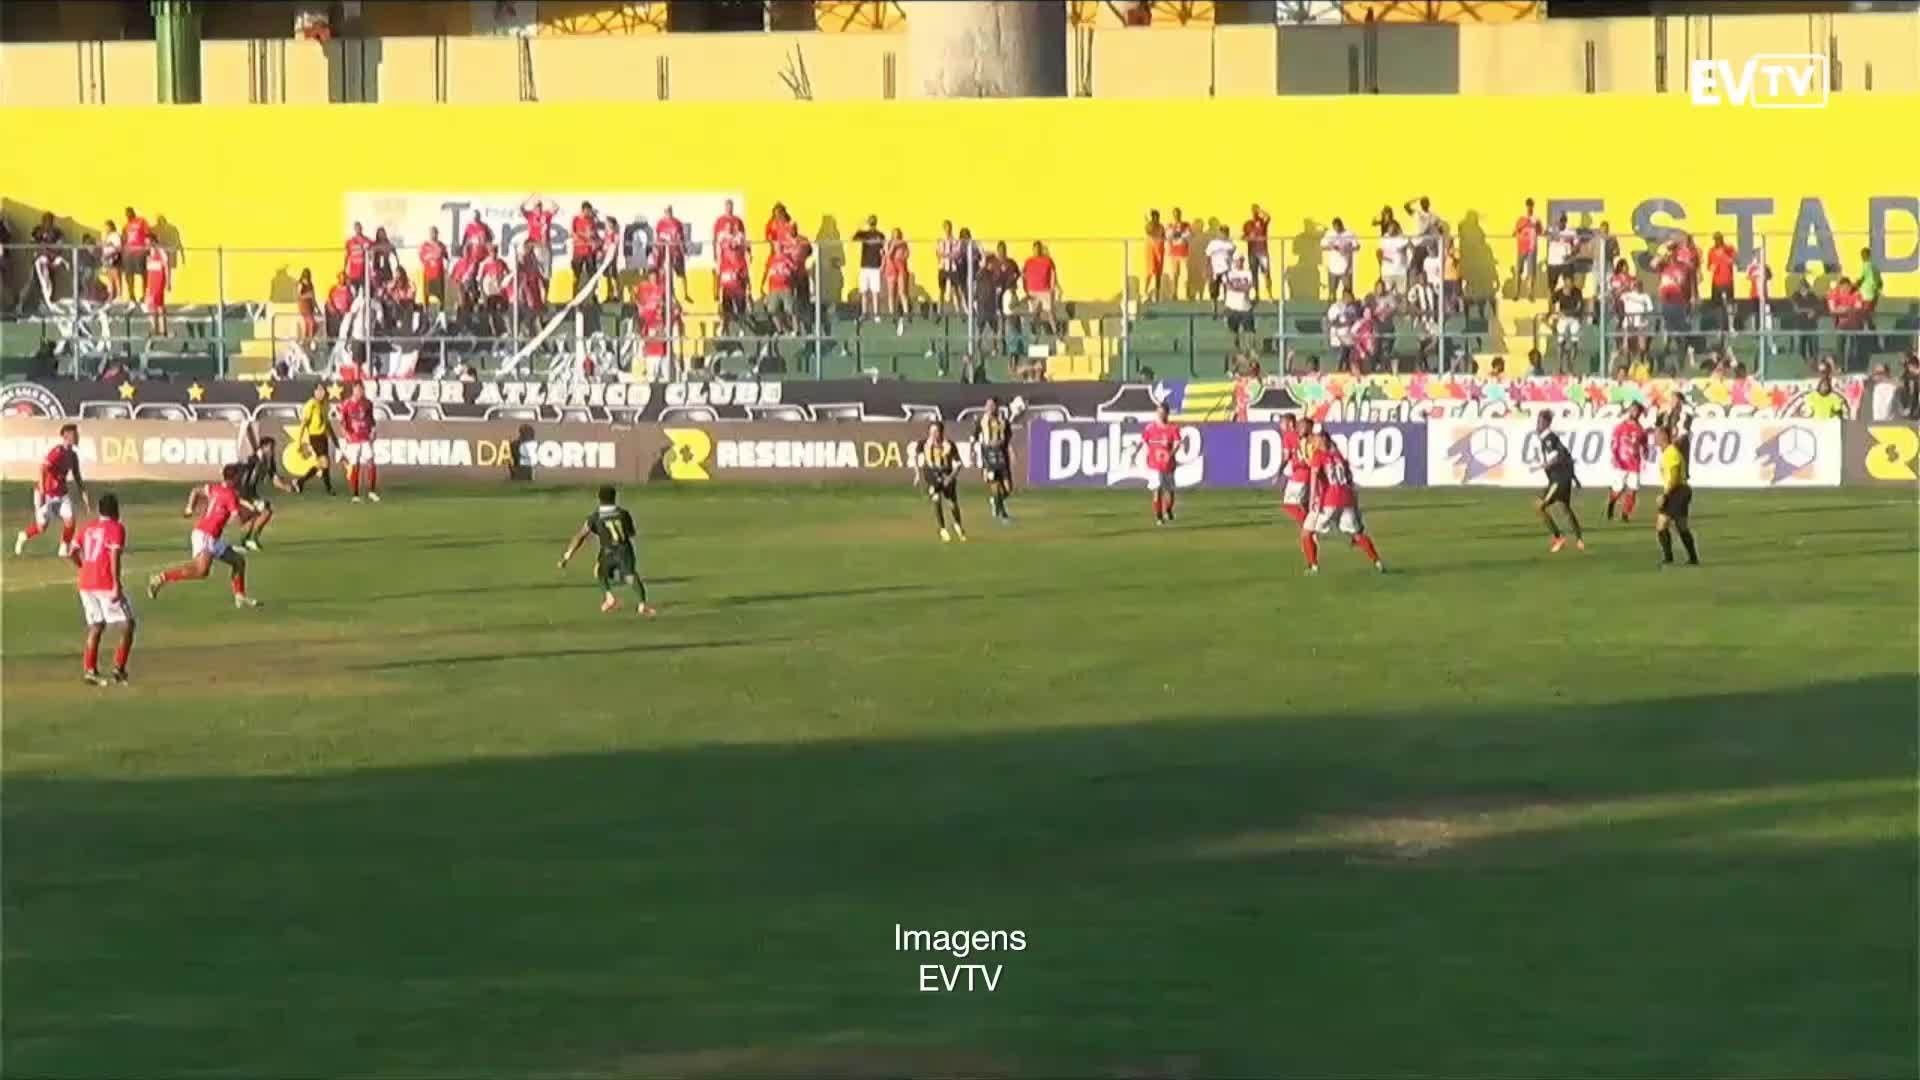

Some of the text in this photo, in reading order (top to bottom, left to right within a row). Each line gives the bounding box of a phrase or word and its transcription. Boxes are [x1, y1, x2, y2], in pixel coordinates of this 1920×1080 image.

[665, 382, 782, 405] CLUBE
[101, 436, 141, 465] DA
[335, 439, 472, 466] SENHA
[477, 440, 514, 466] DA
[717, 440, 859, 468] RESENHA
[864, 441, 902, 468] DA
[1521, 430, 1604, 465] GLO
[83, 527, 105, 560] 17
